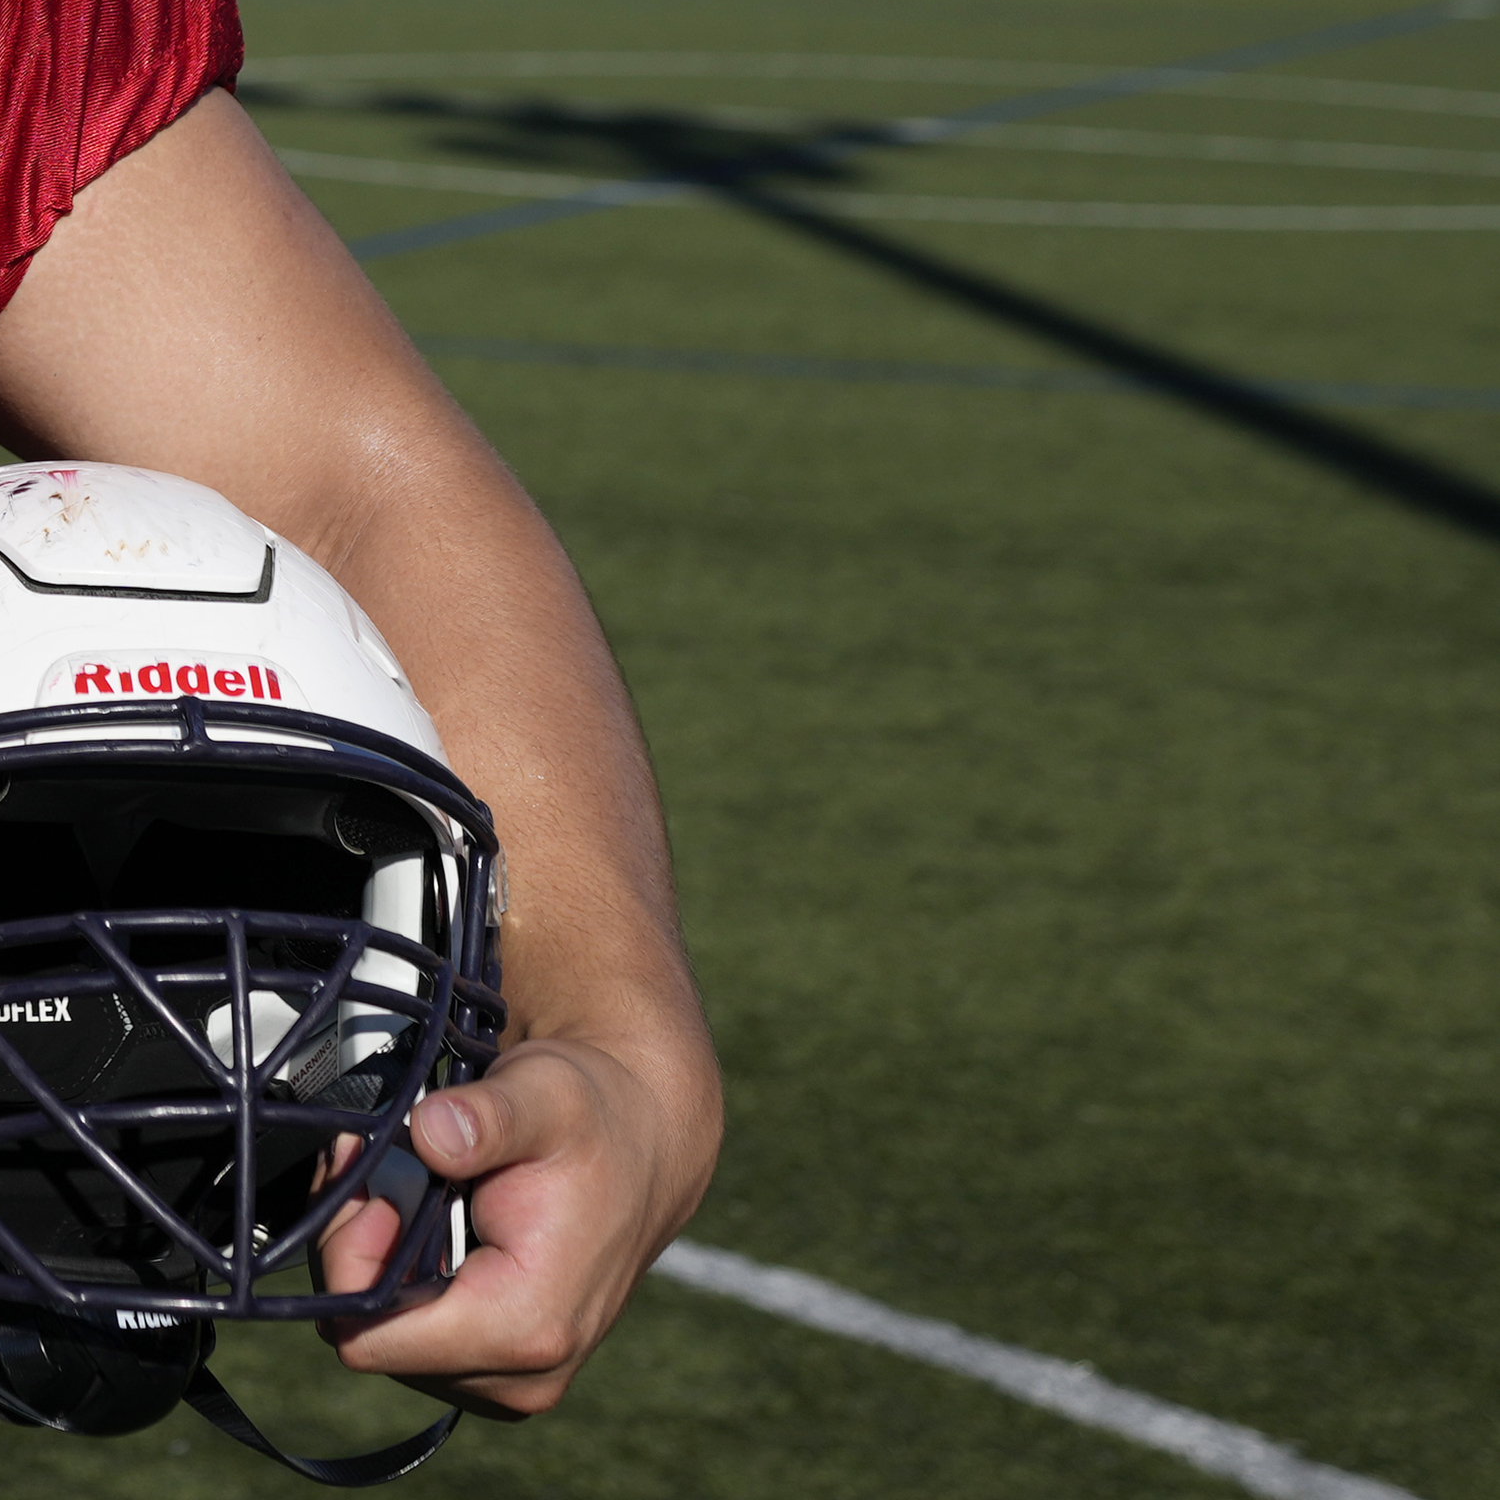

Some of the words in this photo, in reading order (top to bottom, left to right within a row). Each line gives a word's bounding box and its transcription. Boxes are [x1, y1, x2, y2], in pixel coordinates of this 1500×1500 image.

[74, 661, 282, 700] Riddell
[290, 1038, 333, 1087] WARNING
[116, 1309, 190, 1330] Ridd
